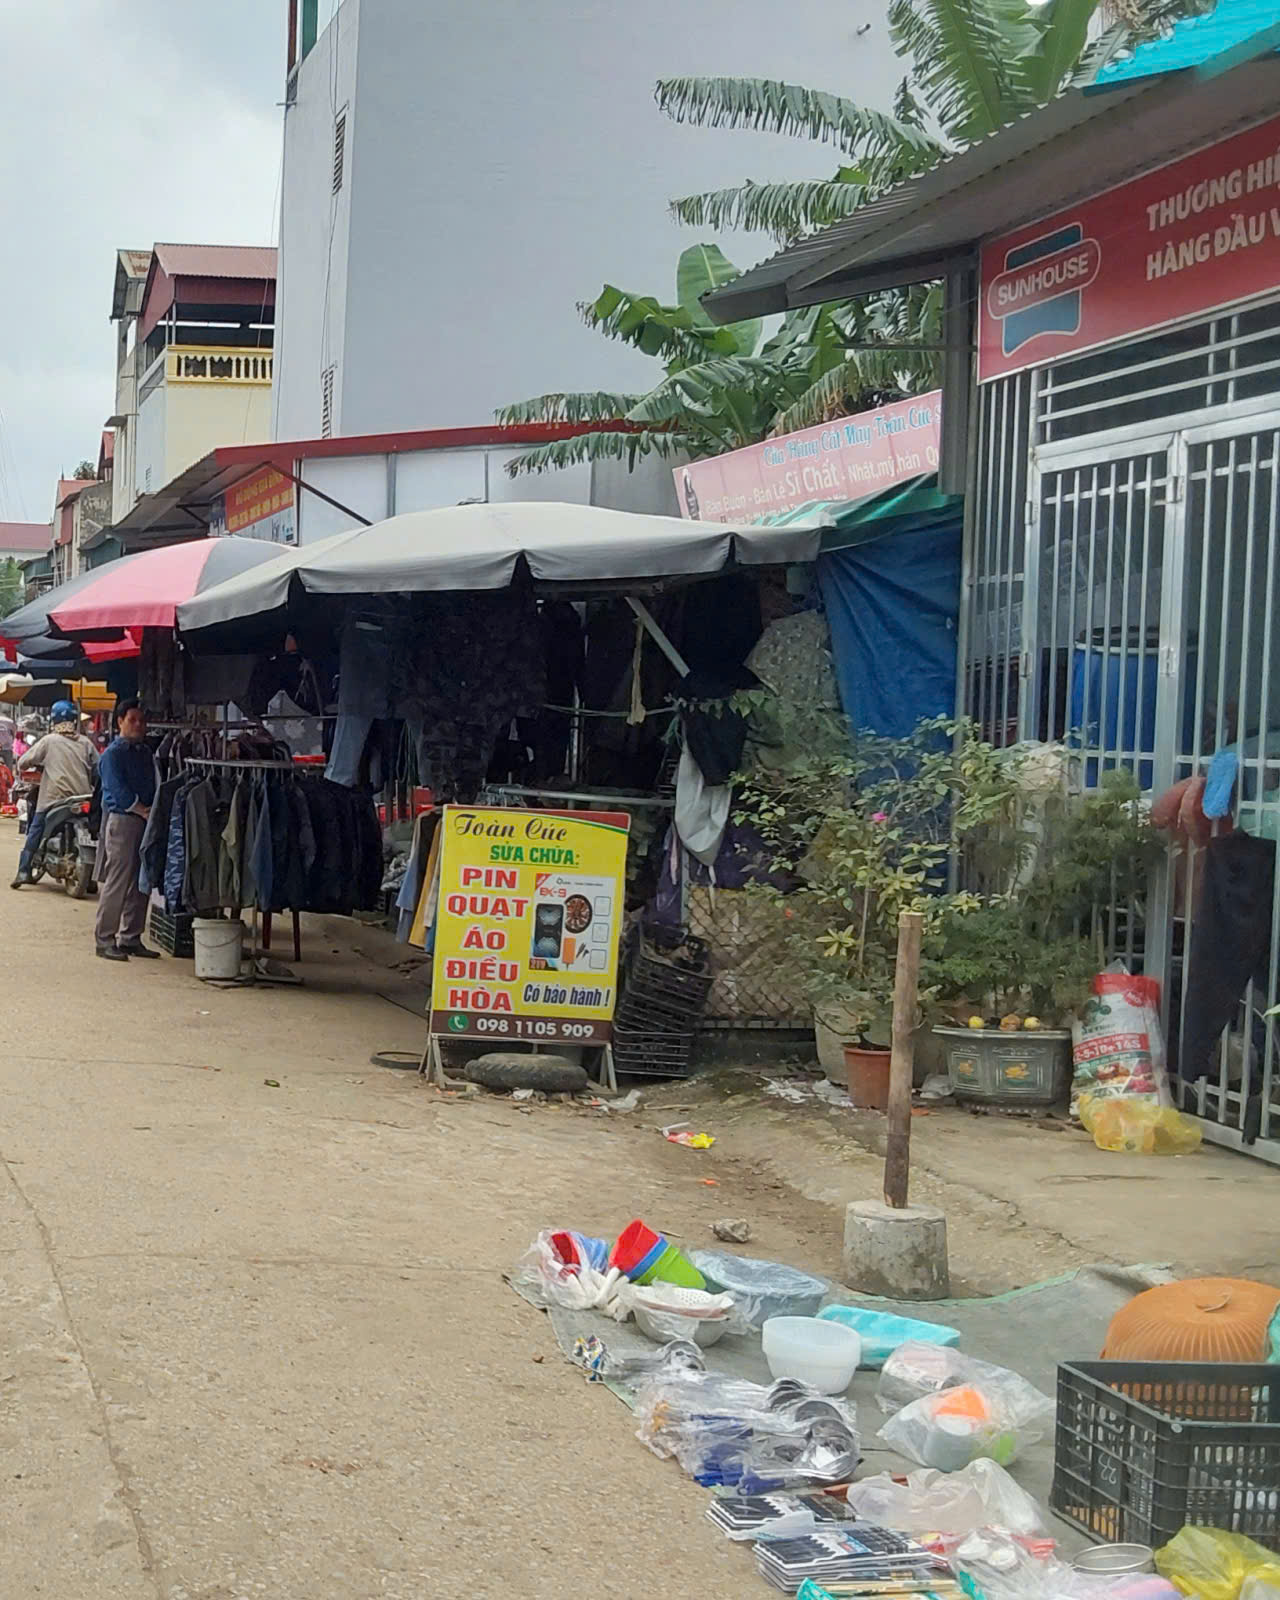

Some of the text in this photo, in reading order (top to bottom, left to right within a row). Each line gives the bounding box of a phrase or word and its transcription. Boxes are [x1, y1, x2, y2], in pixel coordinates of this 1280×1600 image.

[1146, 169, 1241, 231] THƯƠNG
[1146, 235, 1211, 281] HÀNG
[1213, 212, 1266, 256] ĐẦU
[998, 253, 1089, 306] SUNHOUSE
[803, 460, 840, 493] Chất
[453, 813, 568, 842] Toàn Cúc
[462, 868, 517, 888] PIN
[447, 895, 528, 921] QUẠT
[463, 927, 506, 949] ÁO
[446, 956, 519, 981] ĐIỀU
[449, 986, 513, 1011] HÒA
[523, 983, 540, 1002] Có
[569, 987, 603, 1007] hành
[476, 1018, 595, 1038] 098 1105 909
